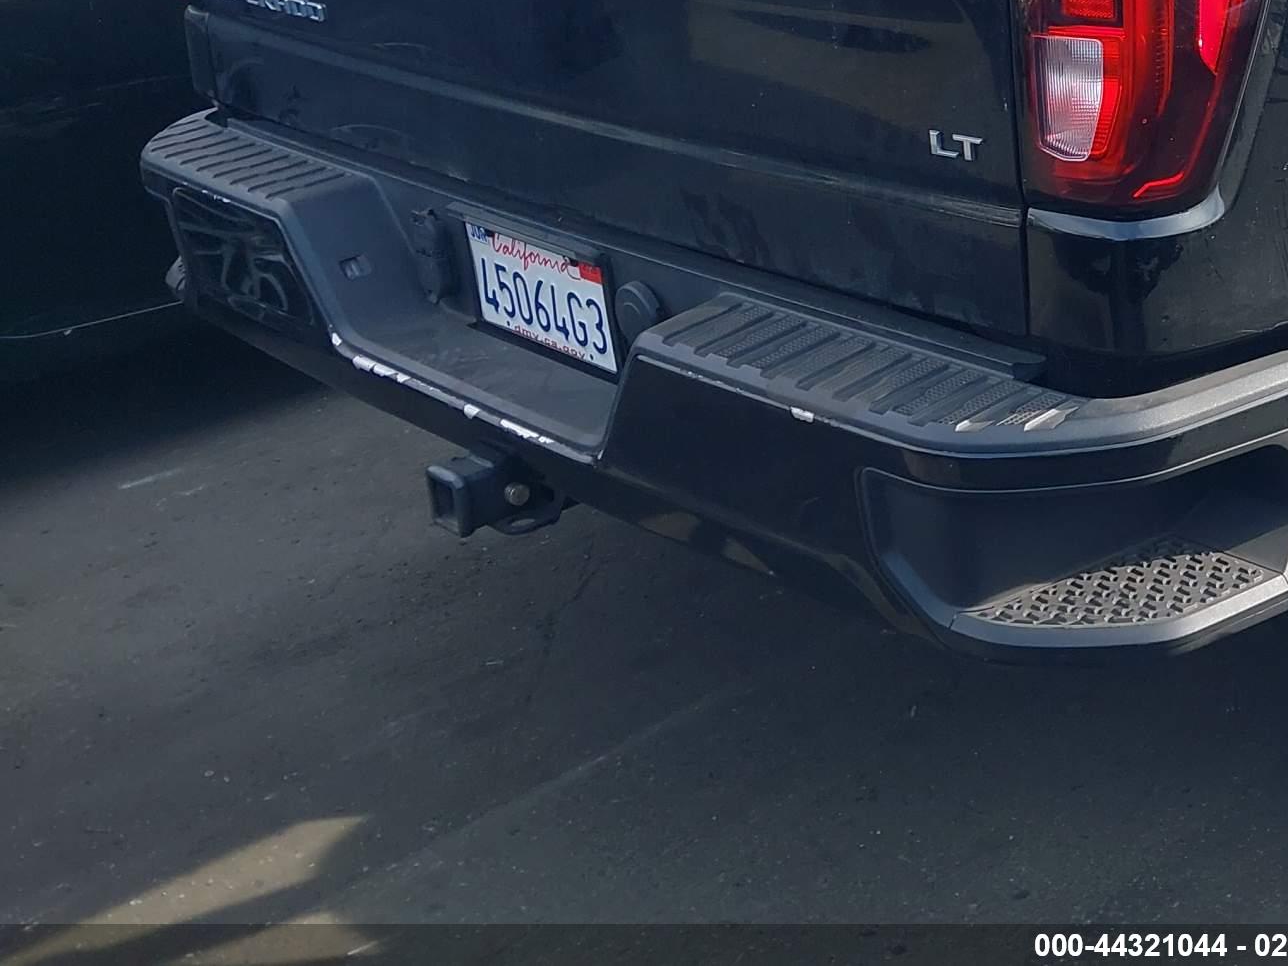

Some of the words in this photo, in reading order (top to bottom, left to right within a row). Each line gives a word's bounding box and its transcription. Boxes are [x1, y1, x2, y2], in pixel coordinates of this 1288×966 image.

[929, 129, 983, 161] LT
[491, 232, 580, 280] California
[480, 257, 608, 355] 45064G3
[513, 324, 587, 362] dmv.ca.gov
